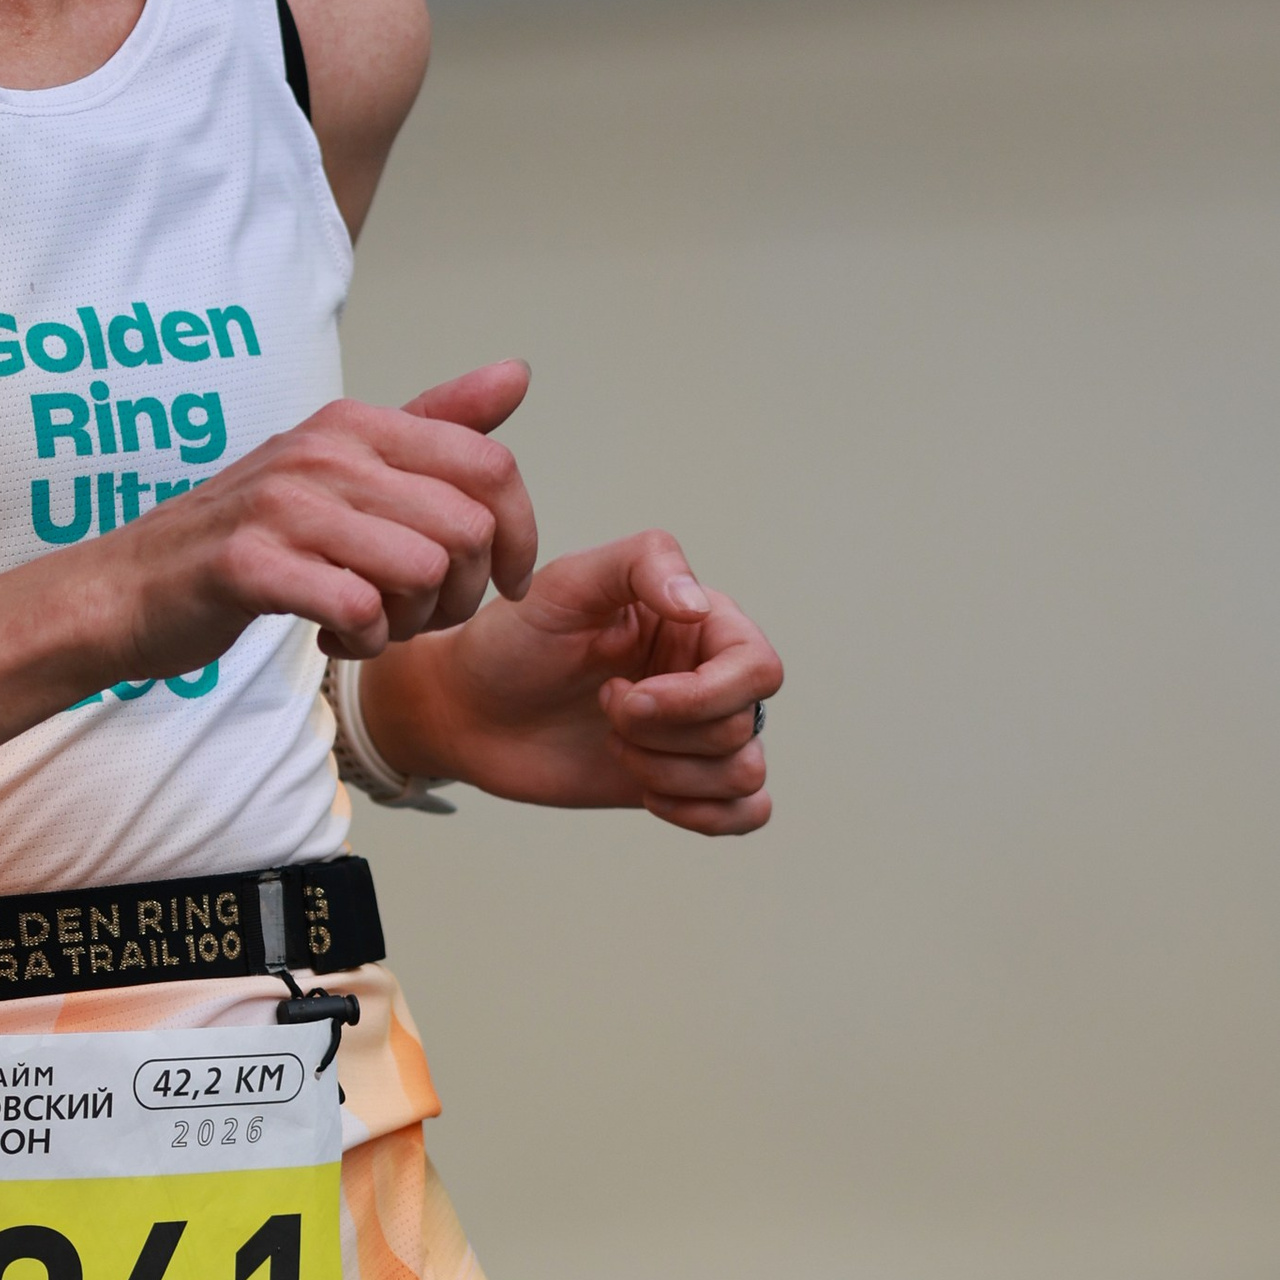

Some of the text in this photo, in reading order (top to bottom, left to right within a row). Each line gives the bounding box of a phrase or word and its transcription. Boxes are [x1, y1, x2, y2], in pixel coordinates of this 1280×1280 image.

[30, 380, 228, 465] Ring
[31, 471, 212, 545] Ultr
[137, 891, 240, 936] RING
[62, 938, 180, 976] TRAIL
[185, 929, 242, 964] 100
[153, 1067, 222, 1099] 42,2
[171, 1116, 265, 1148] 2026
